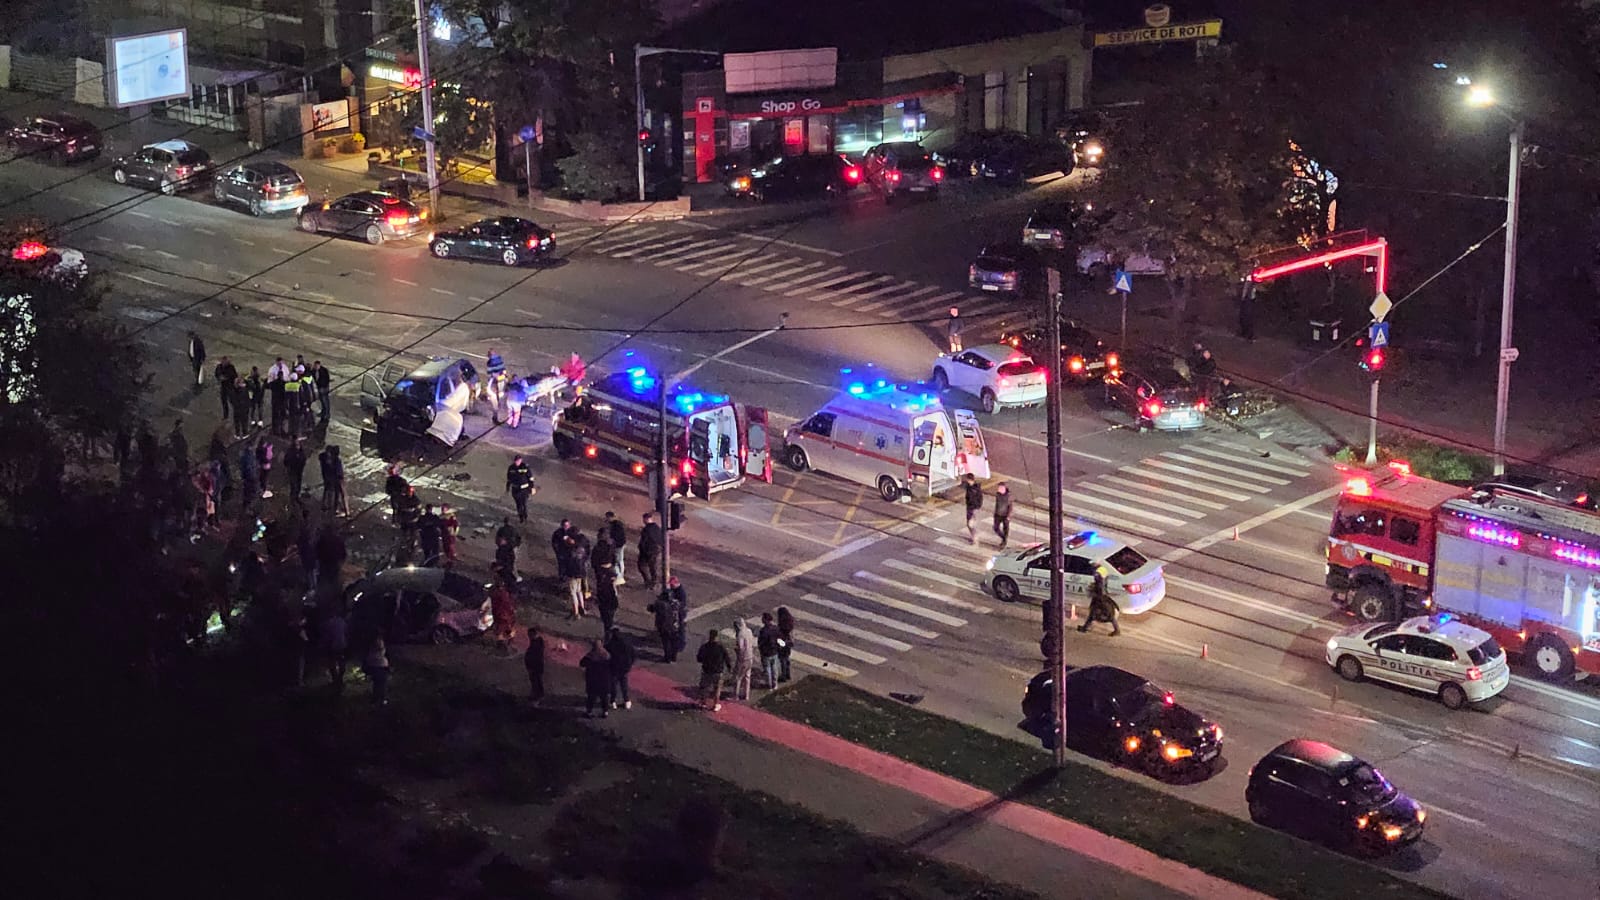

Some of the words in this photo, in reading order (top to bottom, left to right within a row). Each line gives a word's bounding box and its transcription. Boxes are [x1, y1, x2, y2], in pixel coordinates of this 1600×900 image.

[1108, 28, 1157, 43] SERVICE
[1160, 27, 1176, 38] DE
[1179, 24, 1206, 37] ROTI
[761, 101, 796, 113] Shop
[802, 98, 821, 110] Go
[1036, 579, 1084, 593] POTIA
